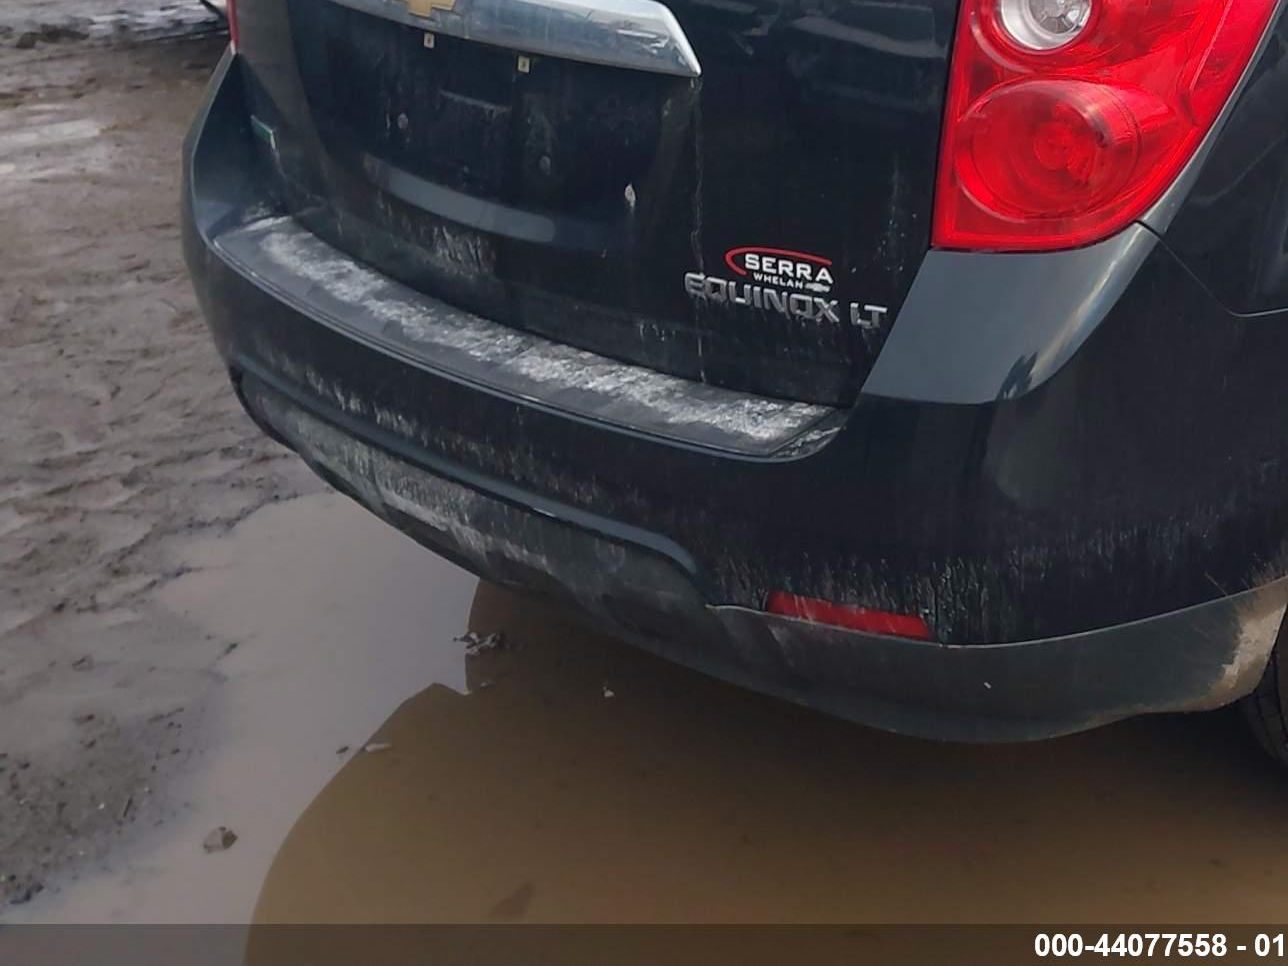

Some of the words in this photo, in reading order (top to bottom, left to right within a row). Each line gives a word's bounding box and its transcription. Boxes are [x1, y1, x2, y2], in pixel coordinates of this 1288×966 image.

[744, 253, 834, 284] SERRA
[753, 272, 804, 290] WHELAN
[684, 272, 840, 324] EQUINOX
[850, 301, 888, 330] LT
